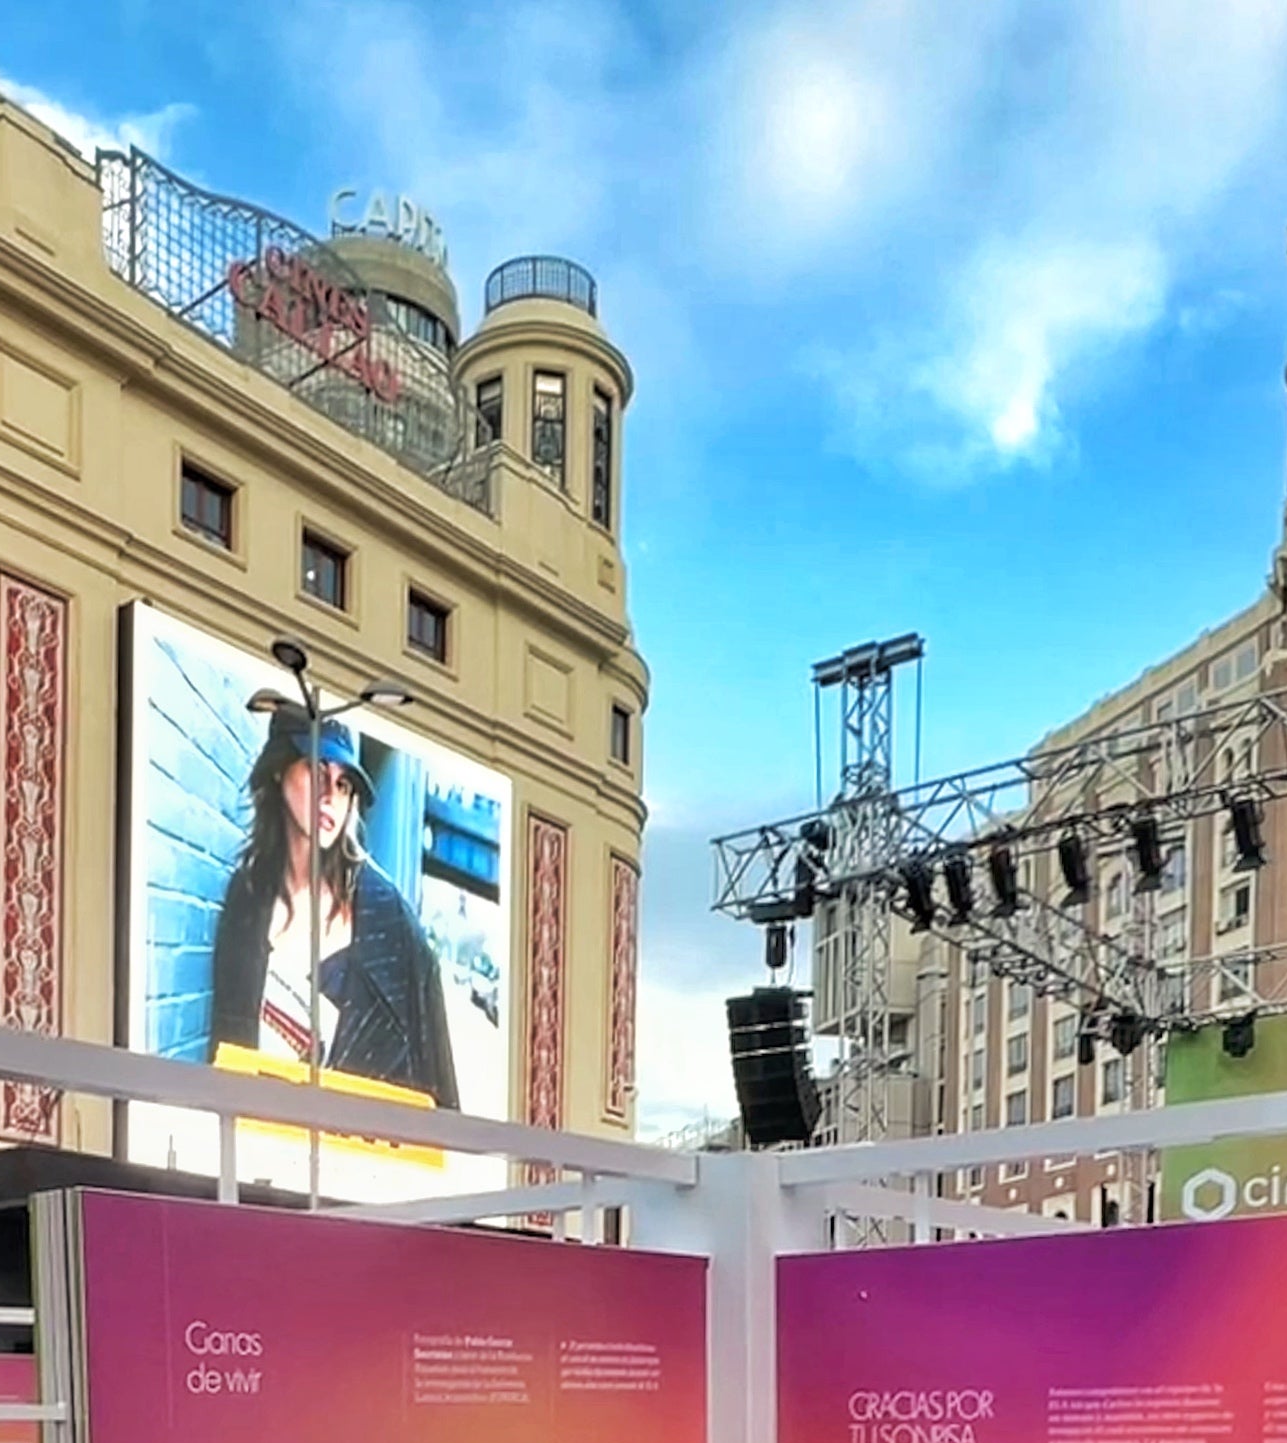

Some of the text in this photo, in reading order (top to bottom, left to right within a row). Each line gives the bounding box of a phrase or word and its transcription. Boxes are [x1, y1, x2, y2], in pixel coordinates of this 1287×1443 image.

[185, 1321, 263, 1356] Ganas
[186, 1361, 262, 1394] de vivir
[848, 1390, 994, 1421] GRACIAS POR
